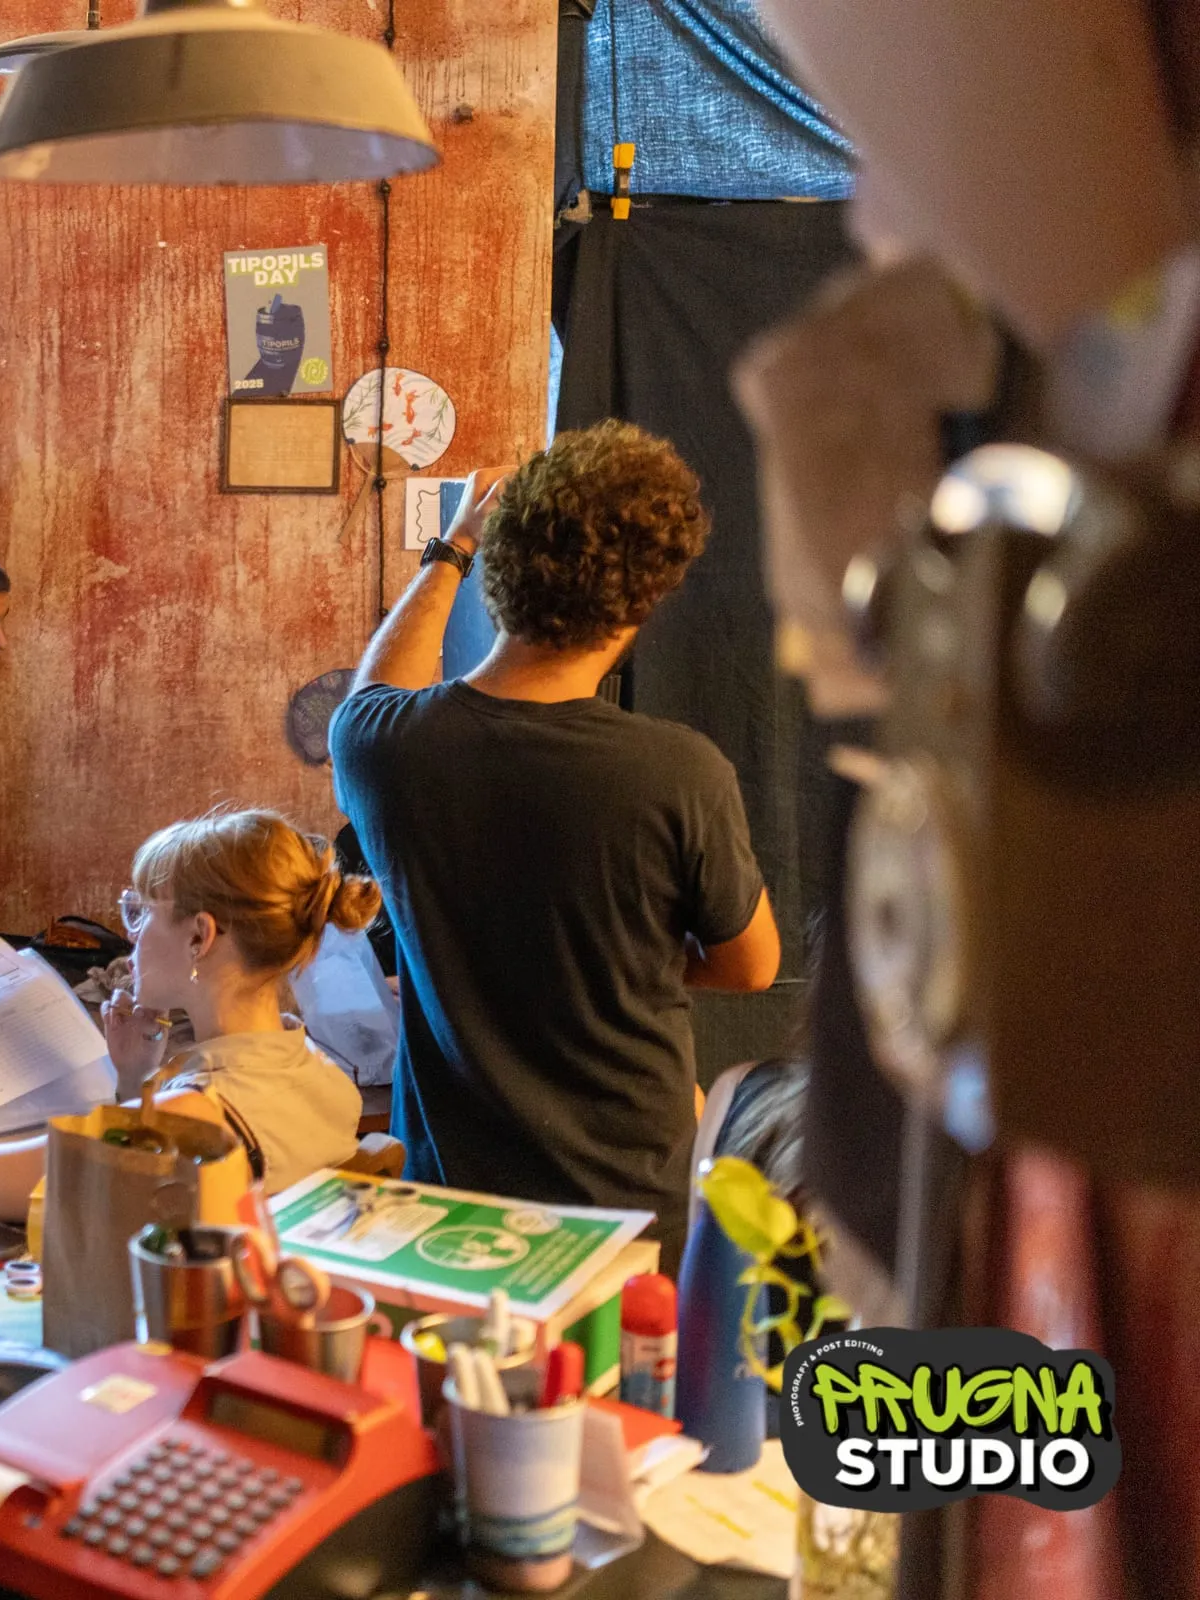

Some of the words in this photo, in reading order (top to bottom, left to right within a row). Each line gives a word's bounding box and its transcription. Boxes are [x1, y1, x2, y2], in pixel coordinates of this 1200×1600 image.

[227, 252, 324, 273] TIPOPILS
[253, 269, 298, 286] DAY
[233, 378, 264, 390] 2025
